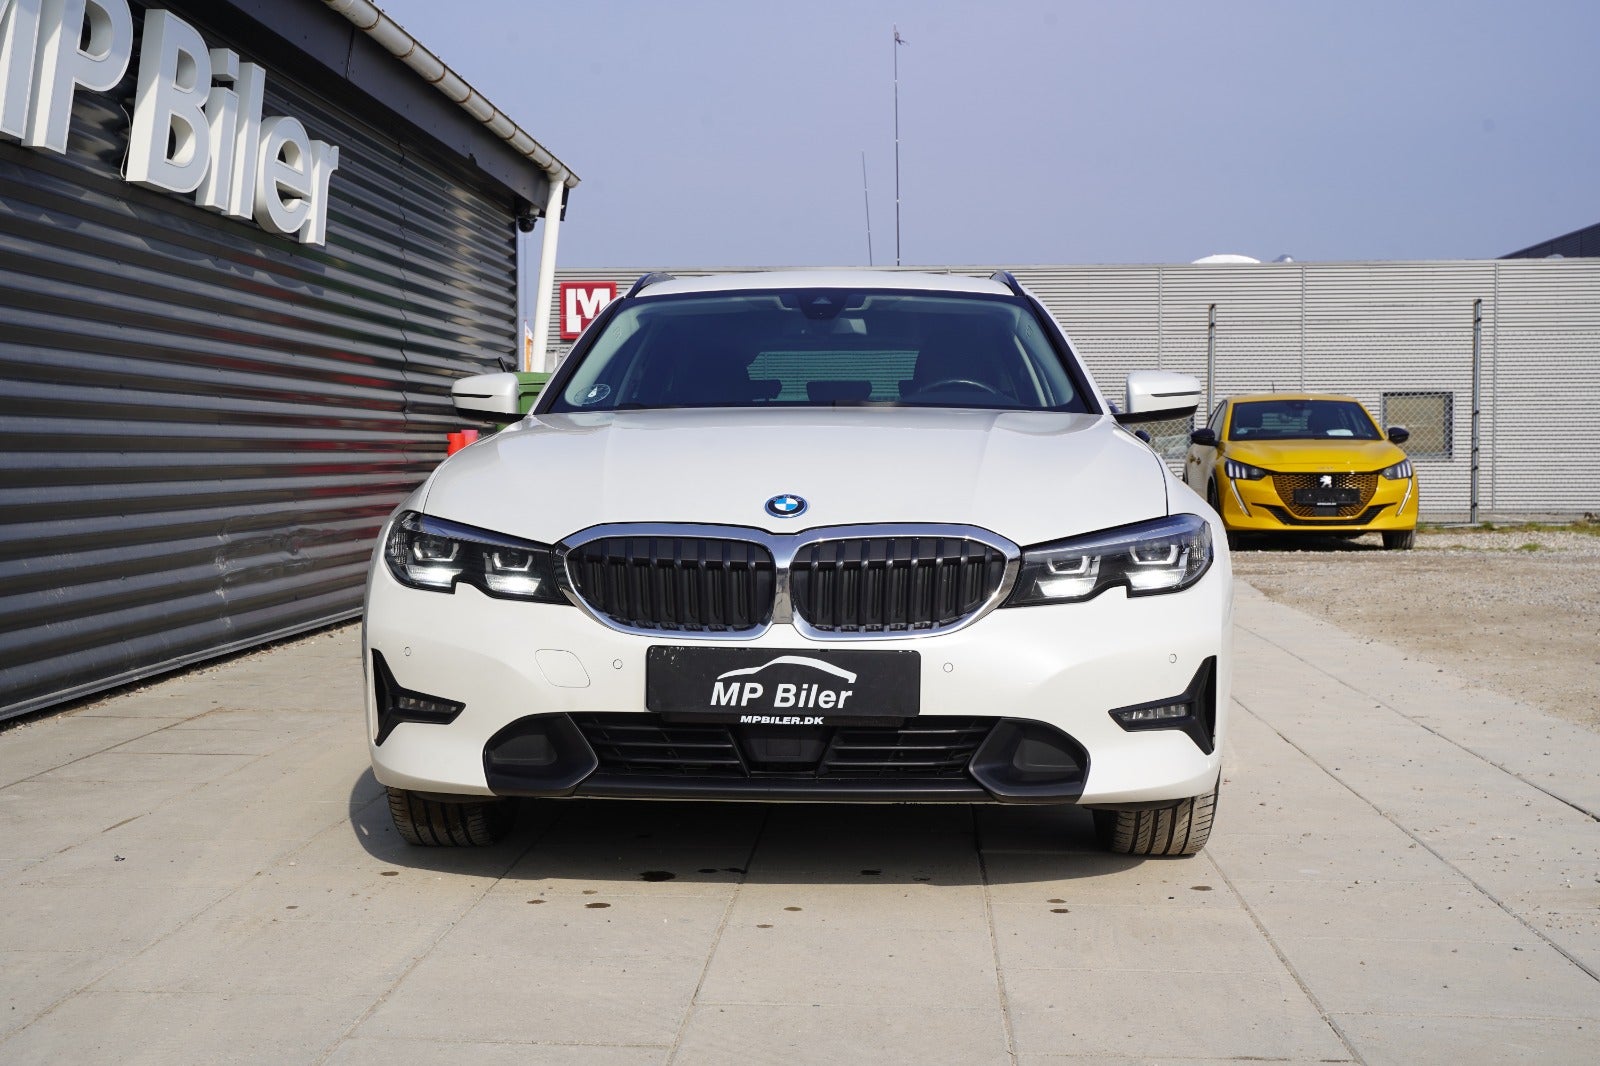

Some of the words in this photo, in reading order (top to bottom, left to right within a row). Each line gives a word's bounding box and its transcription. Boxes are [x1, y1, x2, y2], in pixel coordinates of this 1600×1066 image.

[126, 9, 340, 247] Biler
[710, 681, 763, 706] MP
[774, 683, 853, 709] Biler
[740, 715, 824, 725] MPBILER.DK
